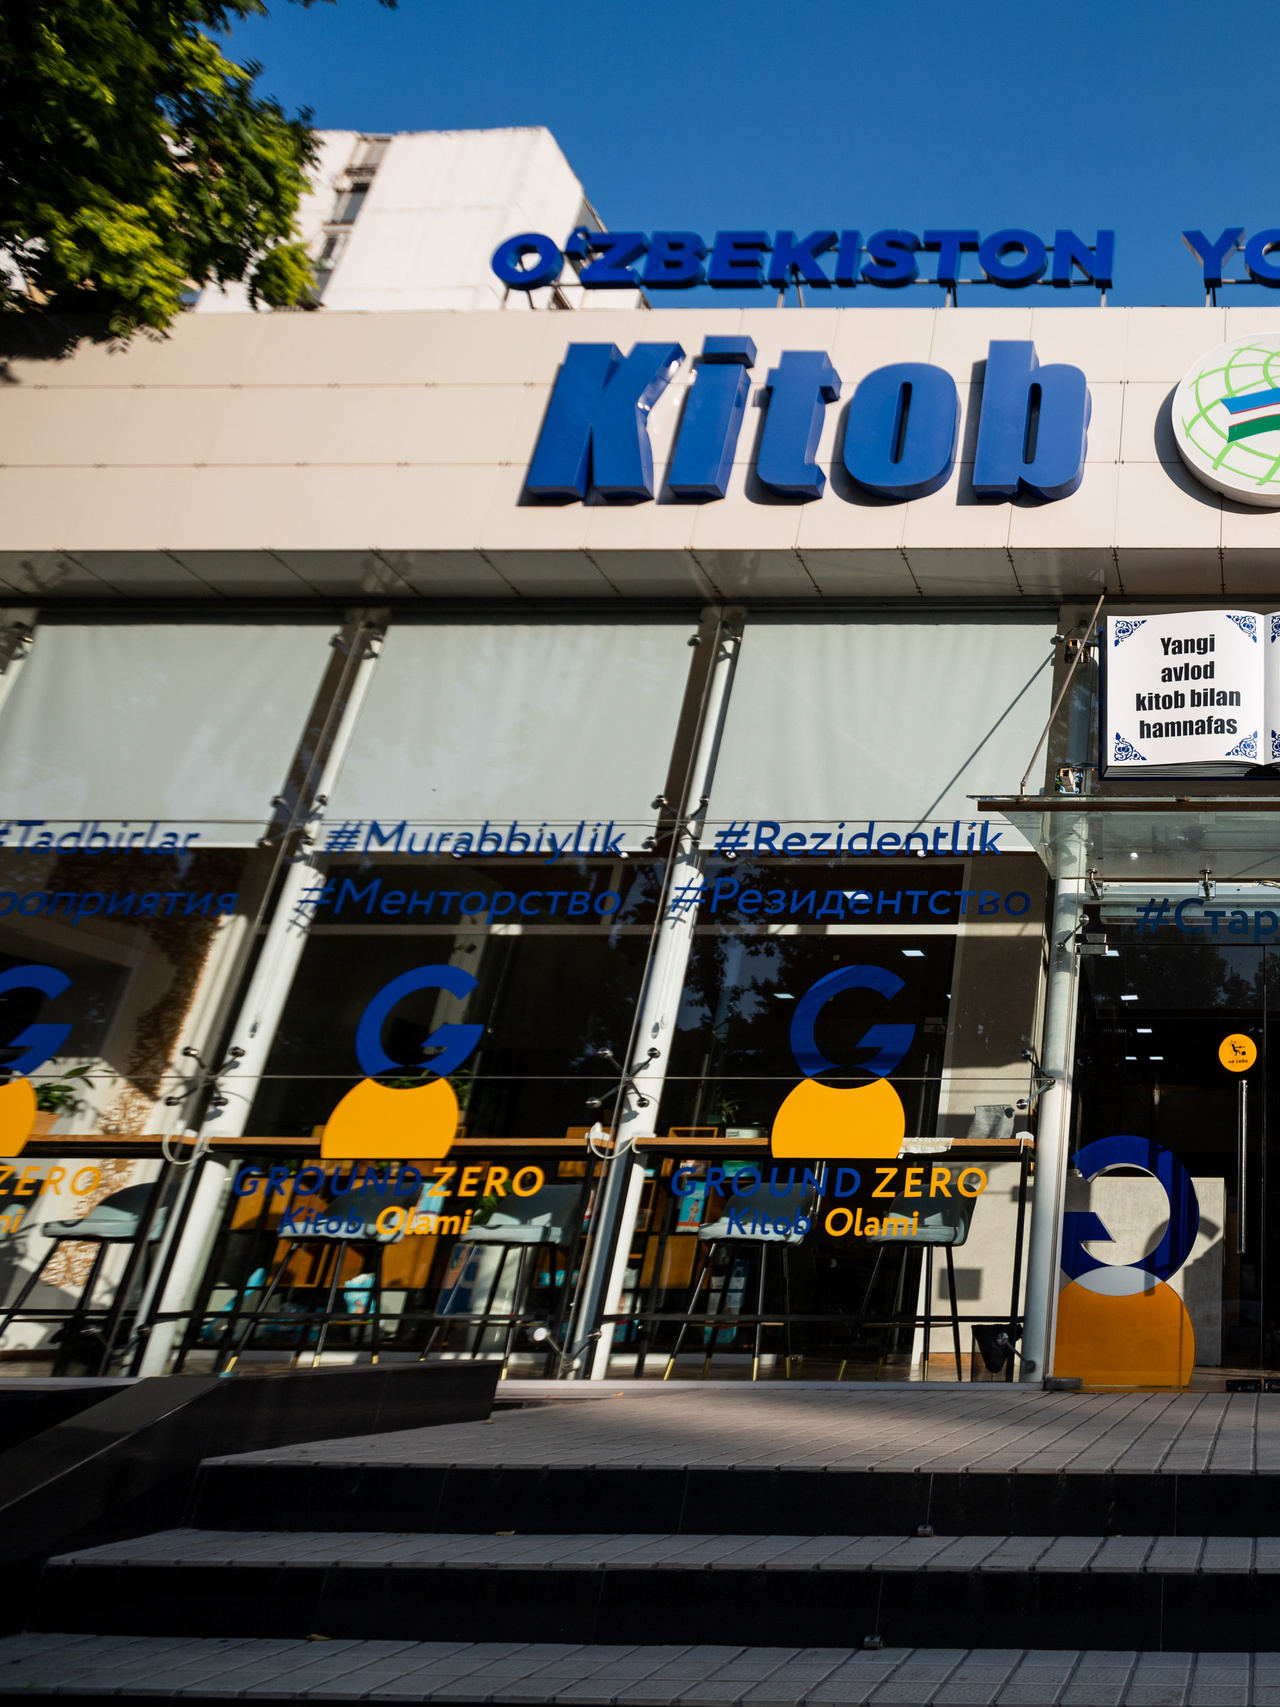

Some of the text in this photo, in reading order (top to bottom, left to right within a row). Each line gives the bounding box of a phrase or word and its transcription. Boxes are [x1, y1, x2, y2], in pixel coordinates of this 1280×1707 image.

[524, 335, 1093, 502] Kitob
[1160, 634, 1216, 656] Yangi
[1161, 661, 1216, 683] avlod
[1135, 688, 1241, 712] kitob bilan
[1139, 716, 1238, 739] hamnafas
[323, 820, 628, 865] #Murabbiylik
[713, 820, 1003, 856] #Rezidentlik
[298, 878, 622, 925] #Менторство
[672, 877, 1031, 919] #Резидентство
[0, 1166, 102, 1196] ZERO
[232, 1166, 545, 1197] GROUND ZERO
[671, 1167, 988, 1198] GROUND ZERO
[278, 1206, 473, 1235] Kitob Olami
[726, 1207, 919, 1236] Kitob Olami
